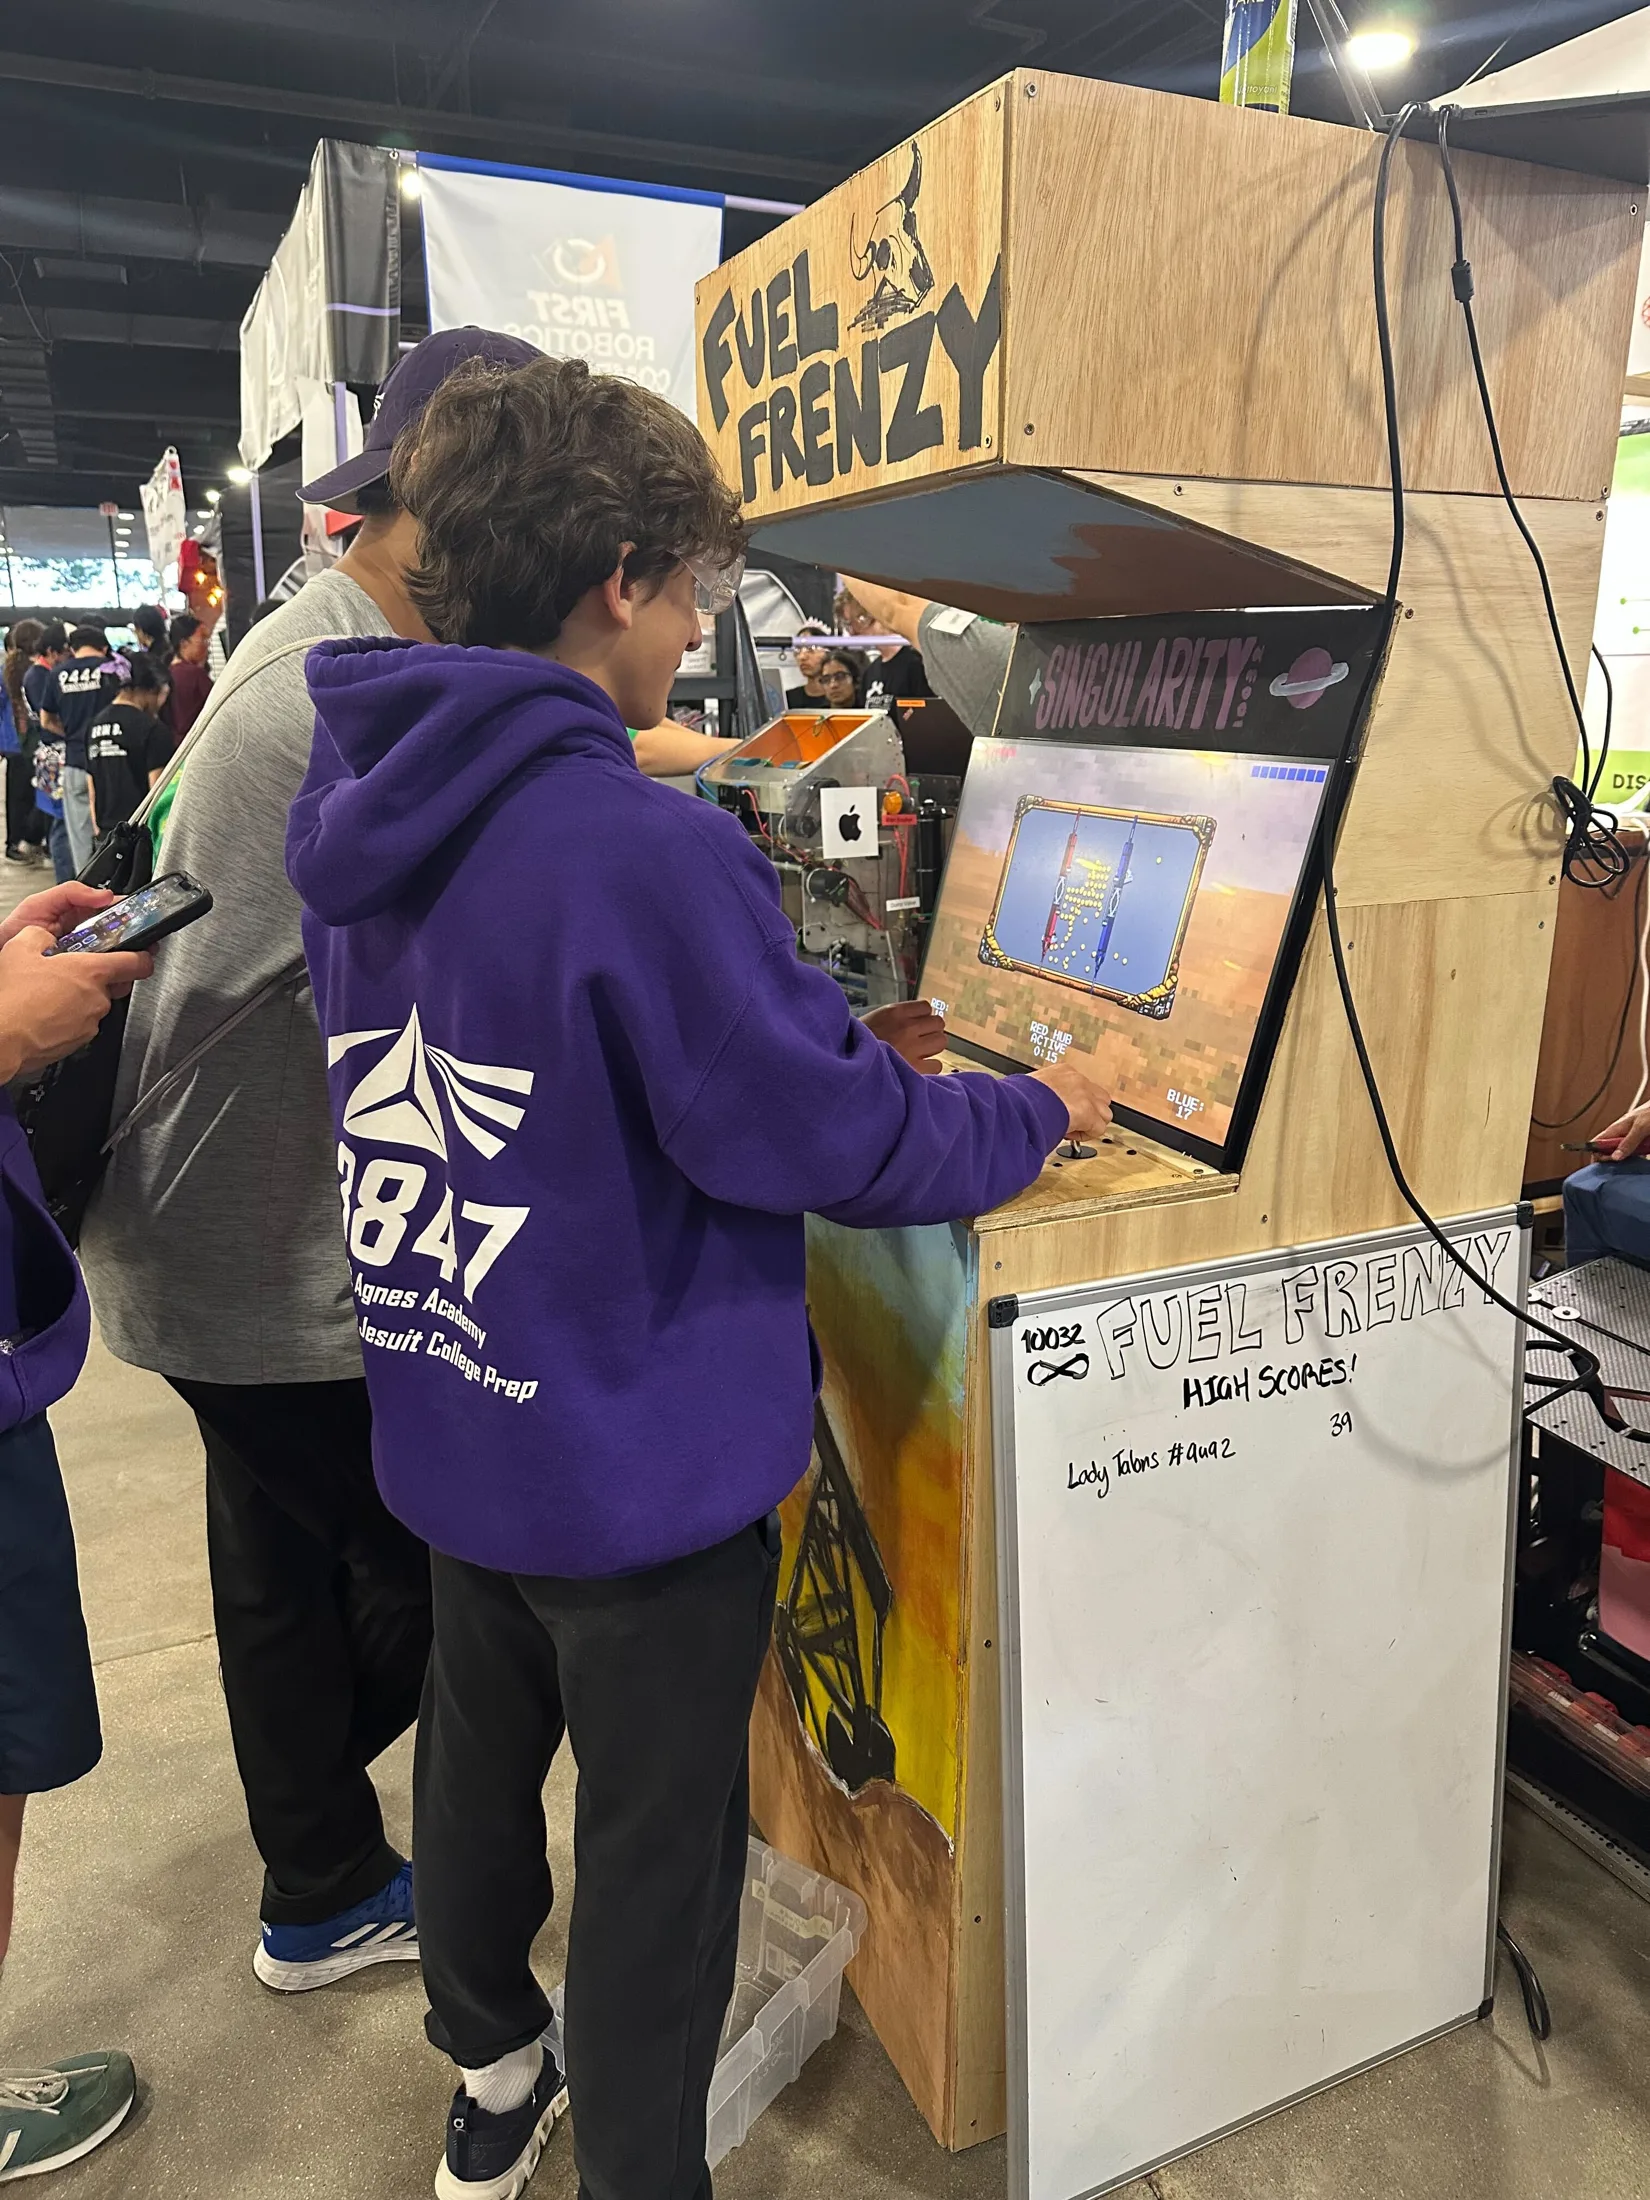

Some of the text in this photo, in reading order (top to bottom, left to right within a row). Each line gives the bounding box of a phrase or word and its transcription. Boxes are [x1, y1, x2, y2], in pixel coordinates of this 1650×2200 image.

[703, 249, 839, 432] FUEL
[737, 252, 1001, 503] FRENZY
[58, 666, 102, 689] 9444
[1035, 637, 1257, 730] SINGULARITY
[931, 997, 949, 1011] RED:
[1030, 1020, 1073, 1046] RED HUB
[1030, 1032, 1068, 1055] ACTIVE
[1034, 1045, 1058, 1064] 0:15
[1167, 1088, 1204, 1112] BLUE:
[1175, 1105, 1193, 1120] 17
[354, 1272, 419, 1309] Agnes
[421, 1288, 487, 1350] Academy
[1096, 1231, 1512, 1381] FUEL FRENZY
[1021, 1323, 1086, 1353] 10032
[359, 1316, 539, 1404] Jesuit College Prep
[1183, 1354, 1358, 1409] HIGH SCORES!
[1330, 1411, 1353, 1437] 39
[1067, 1461, 1111, 1499] Lady
